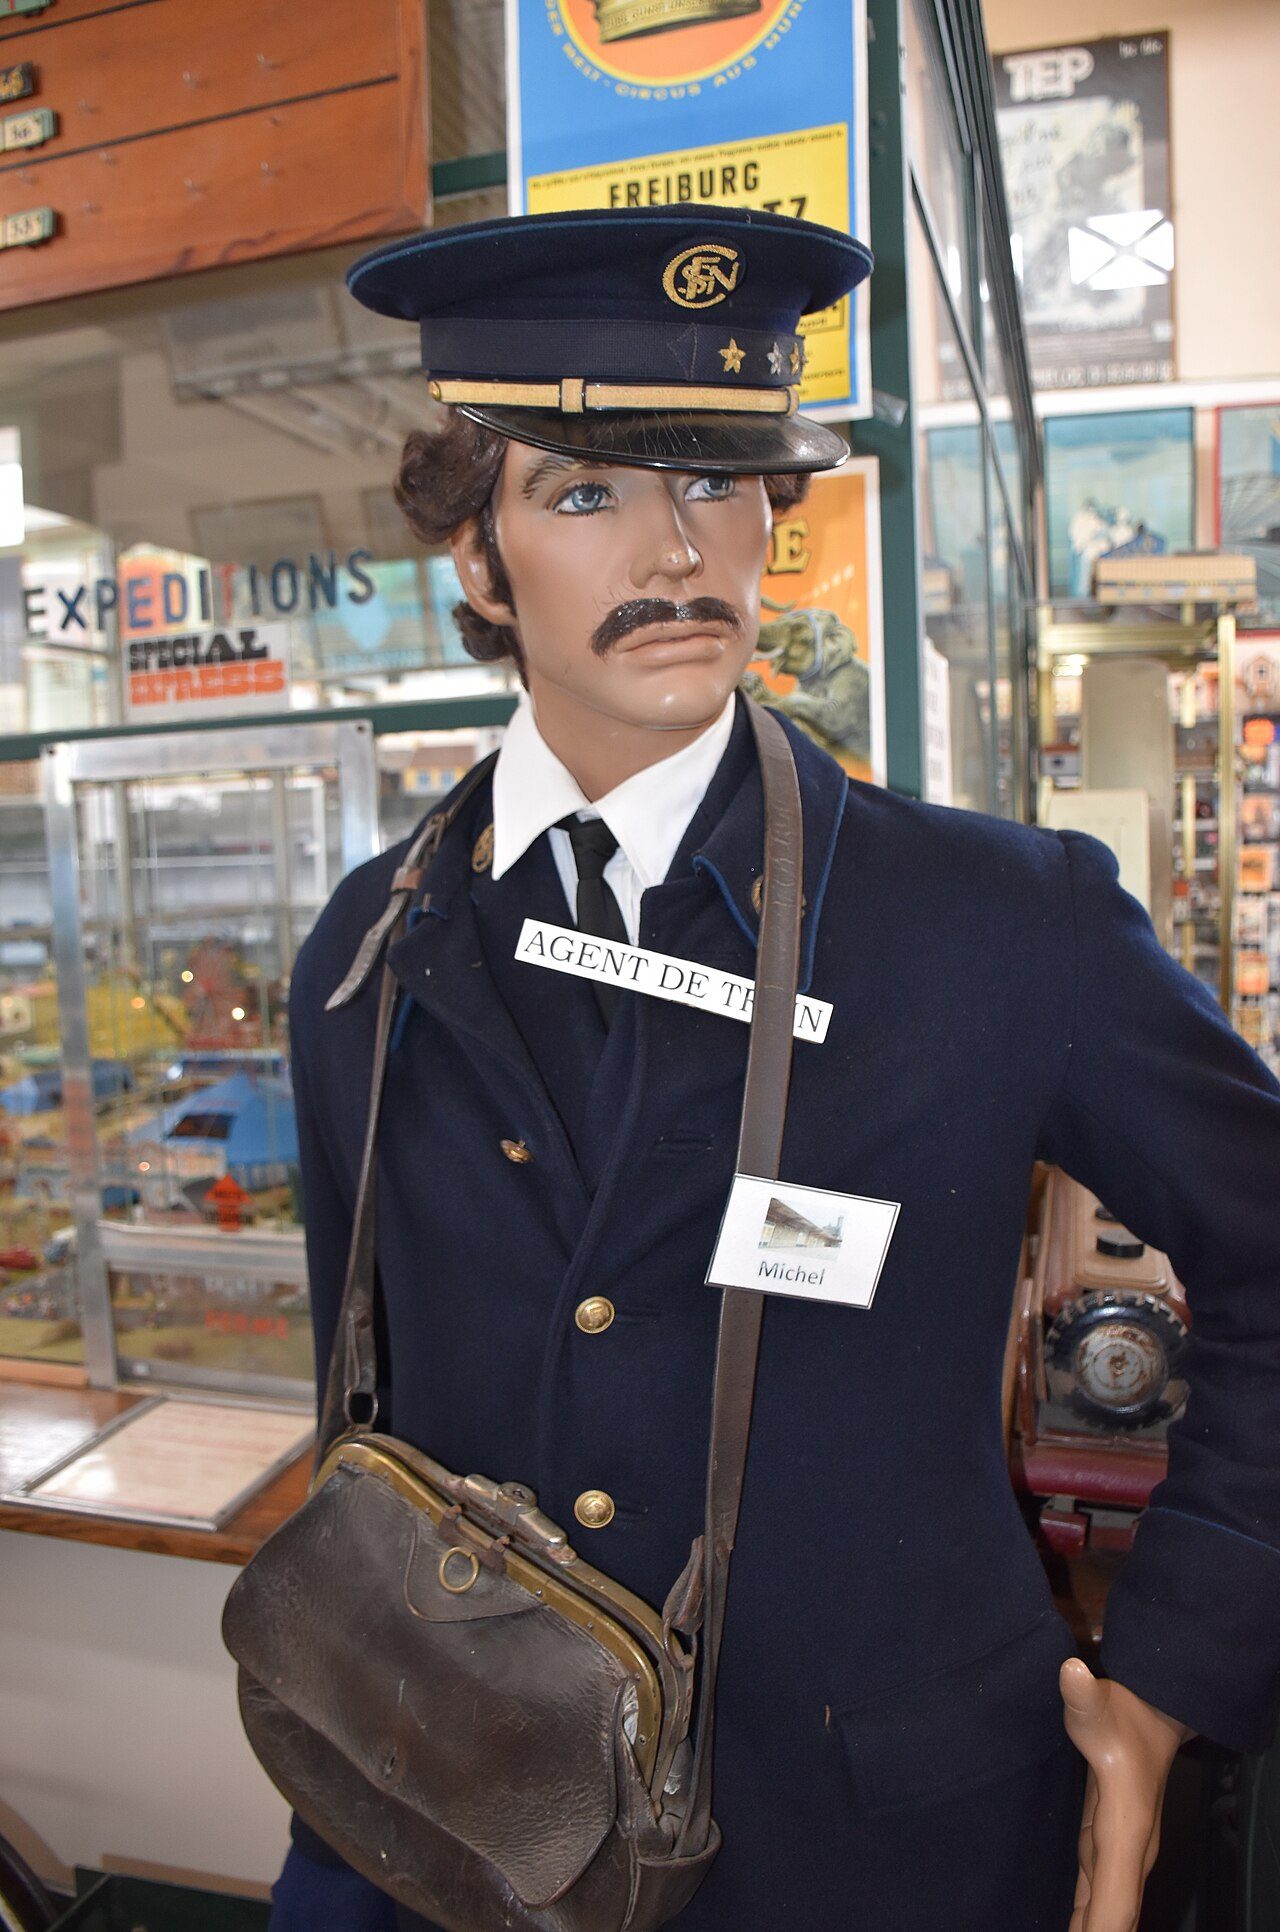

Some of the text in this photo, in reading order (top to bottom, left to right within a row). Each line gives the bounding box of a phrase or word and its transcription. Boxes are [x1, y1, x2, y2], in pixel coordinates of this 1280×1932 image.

[615, 82, 702, 100] CIRCUS
[713, 55, 757, 88] AUS
[609, 161, 759, 209] FREIBURG
[761, 517, 811, 575] E
[22, 549, 375, 639] EXPEDITIONS
[524, 930, 824, 1032] AGENT DE TRN
[758, 1260, 826, 1286] Michel
